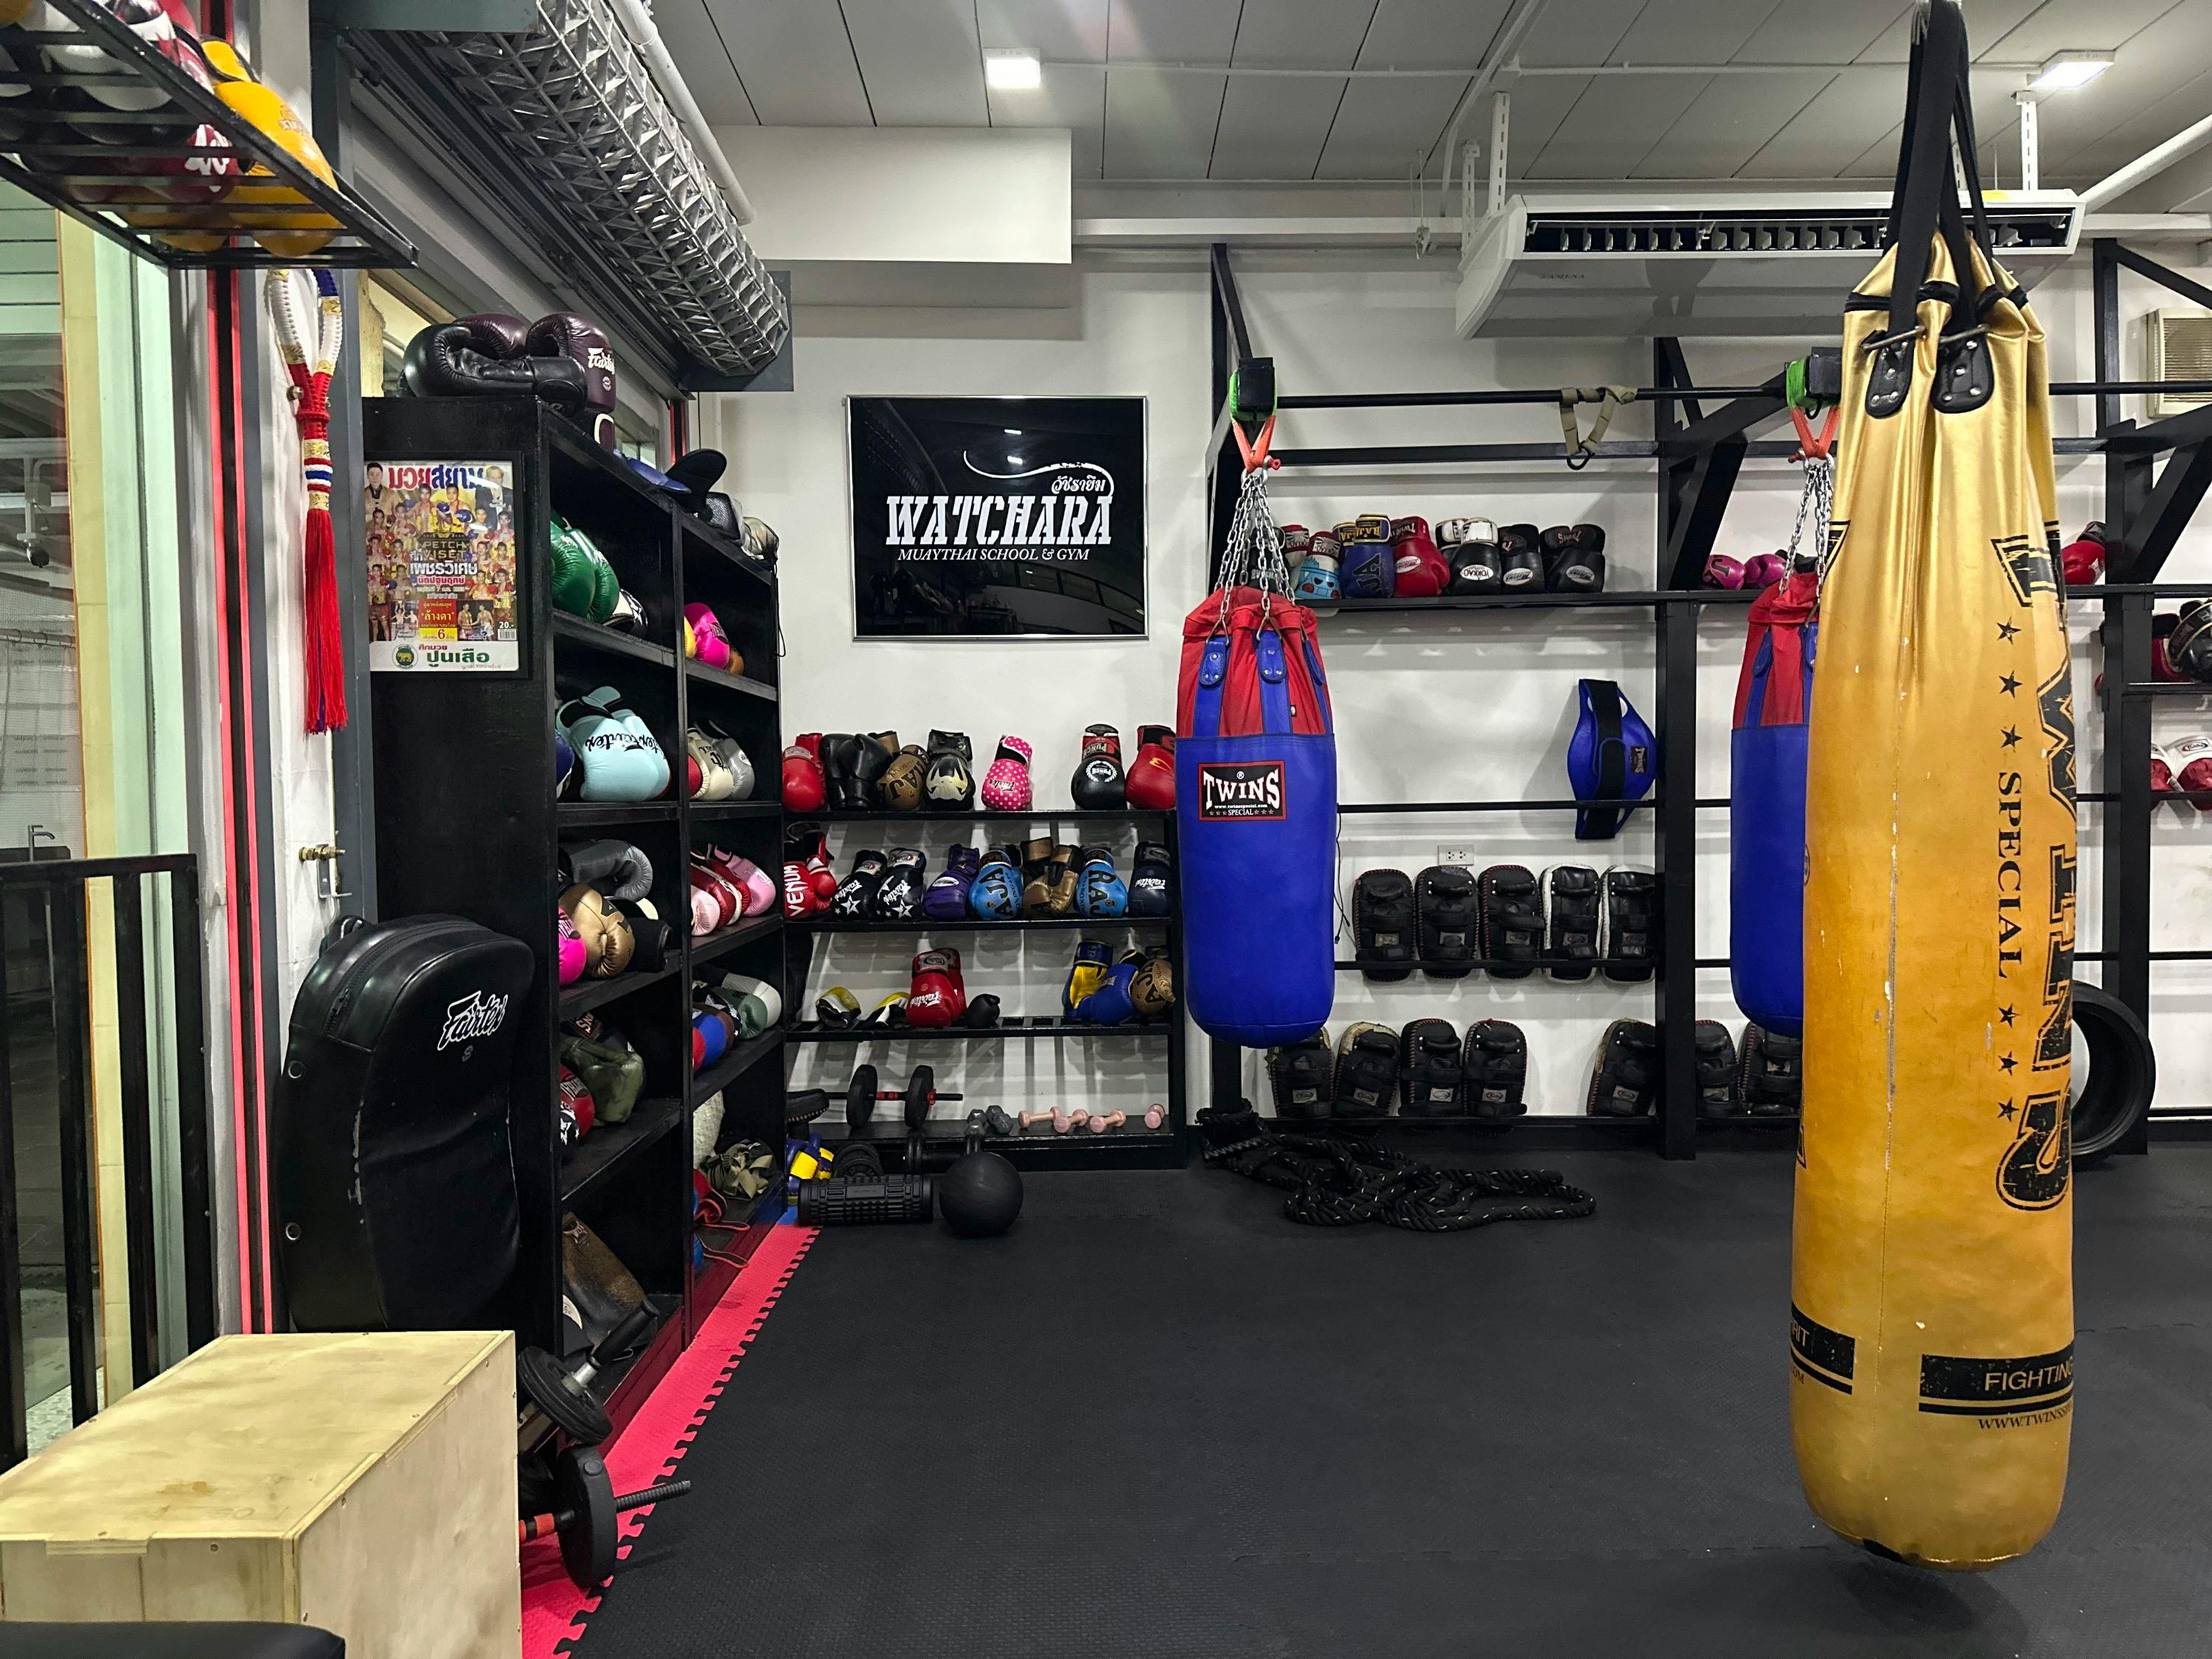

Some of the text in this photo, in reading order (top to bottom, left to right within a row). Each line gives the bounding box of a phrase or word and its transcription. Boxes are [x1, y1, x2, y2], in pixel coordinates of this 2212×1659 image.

[389, 464, 484, 490] มวยสยาม
[886, 495, 1113, 545] WATCHARA
[422, 540, 462, 549] PETCH
[423, 550, 466, 559] VISET
[897, 549, 1089, 561] MUAYTHAI SCHOOL & GYM
[410, 560, 478, 574] เพชรวิเศษ
[1463, 568, 1491, 577] YOKKAO
[437, 628, 445, 639] 6
[427, 648, 490, 667] ปูนเสือ
[1634, 746, 1644, 773] TWINS
[1203, 768, 1280, 810] TWINS
[1998, 771, 2022, 979] SPECIAL
[784, 865, 809, 917] VENUM
[1088, 870, 1116, 917] RAJ
[909, 991, 940, 1007] Fairtex
[437, 990, 508, 1051] Fairtex
